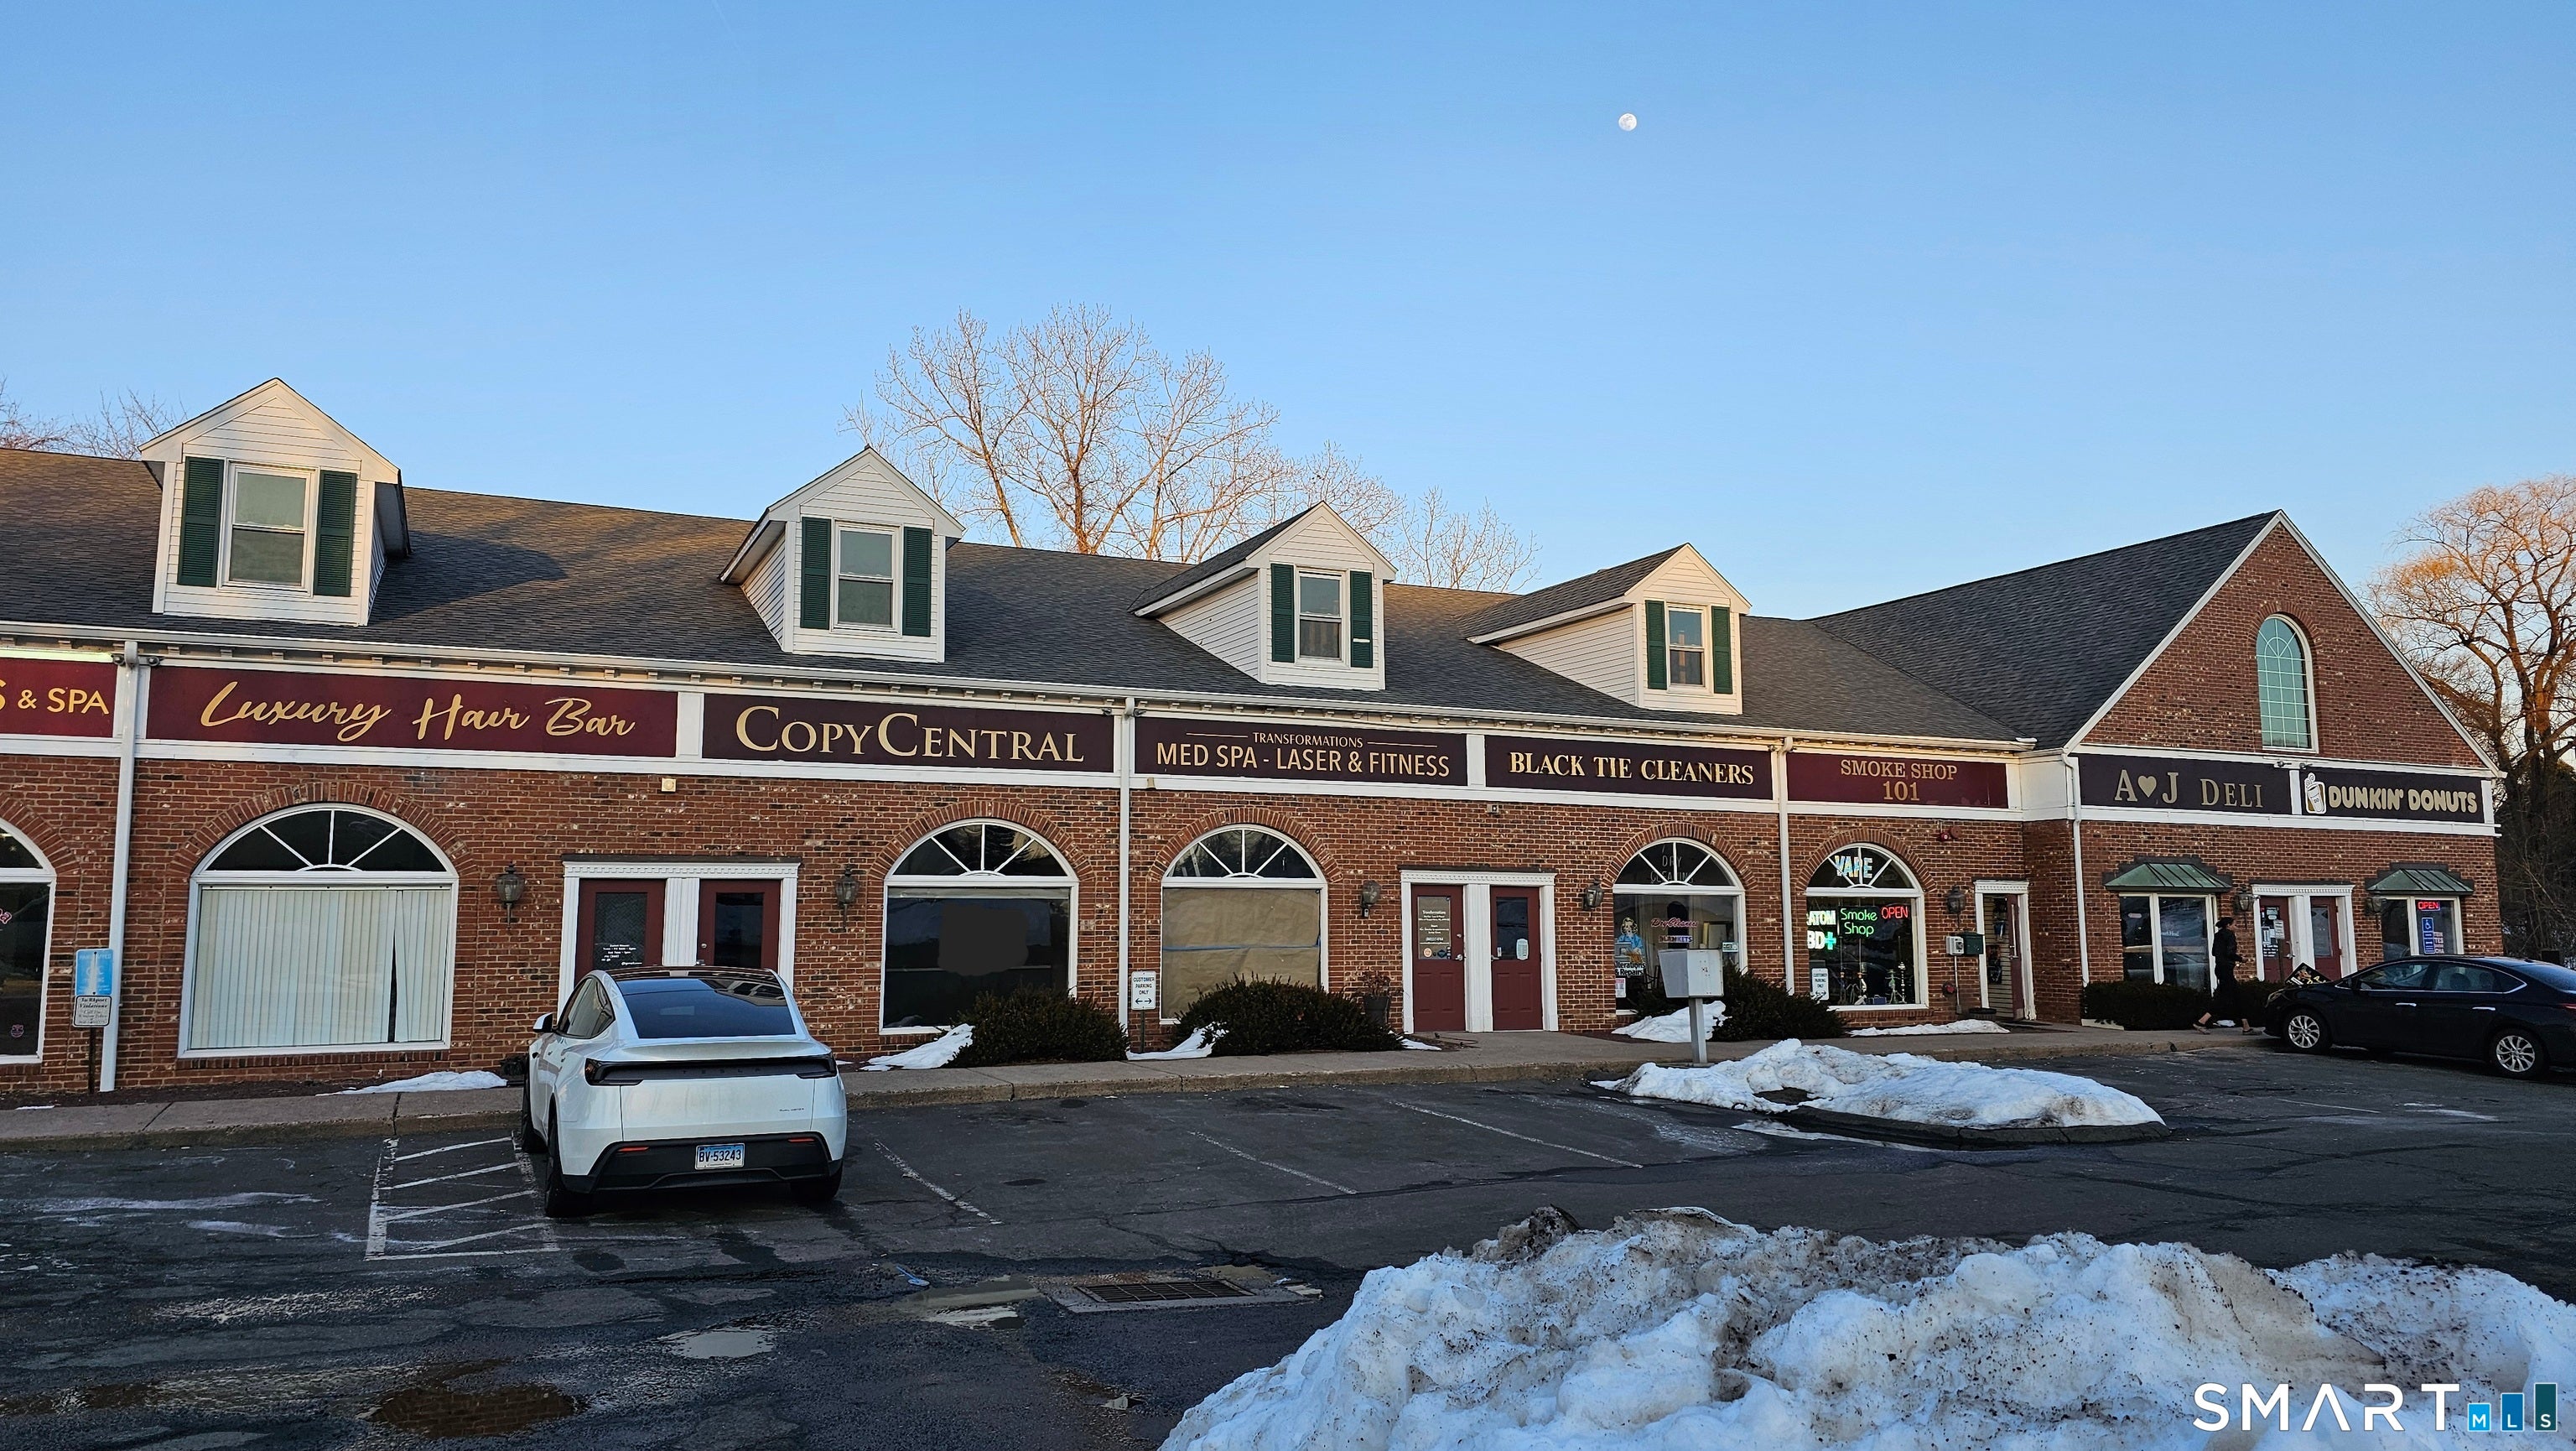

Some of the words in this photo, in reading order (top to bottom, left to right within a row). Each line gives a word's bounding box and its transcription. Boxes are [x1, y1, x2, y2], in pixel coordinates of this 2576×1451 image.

[18, 689, 37, 710] &
[47, 687, 110, 715] SPA
[200, 681, 392, 741] Luxury
[413, 693, 530, 741] Hair
[544, 697, 636, 736] Bar
[1252, 731, 1363, 749] TRANSFORMATIONS
[1156, 742, 1209, 767] MED
[1216, 745, 1258, 769] SPA
[1276, 747, 1342, 772] LASER
[1348, 752, 1363, 773] &
[1369, 752, 1450, 778] FITNESS
[1509, 752, 1585, 777] BLACK
[1593, 757, 1633, 778] TIE
[1641, 759, 1754, 785] CLEANERS
[1841, 759, 1906, 778] SMOKE
[1911, 763, 1958, 780] SHOP
[1883, 781, 1920, 801] 101
[2199, 778, 2263, 808] DELI
[2328, 785, 2403, 810] DUNKIN'
[2407, 789, 2477, 814] DONUTS
[1834, 855, 1873, 878] VAPE
[1806, 910, 1836, 925] ATOM
[1841, 908, 1877, 921] Smoke
[1881, 906, 1909, 919] OPEN
[1658, 934, 1693, 944] BLANKETS
[1844, 922, 1875, 937] Shop
[1620, 968, 1644, 977] Repairs
